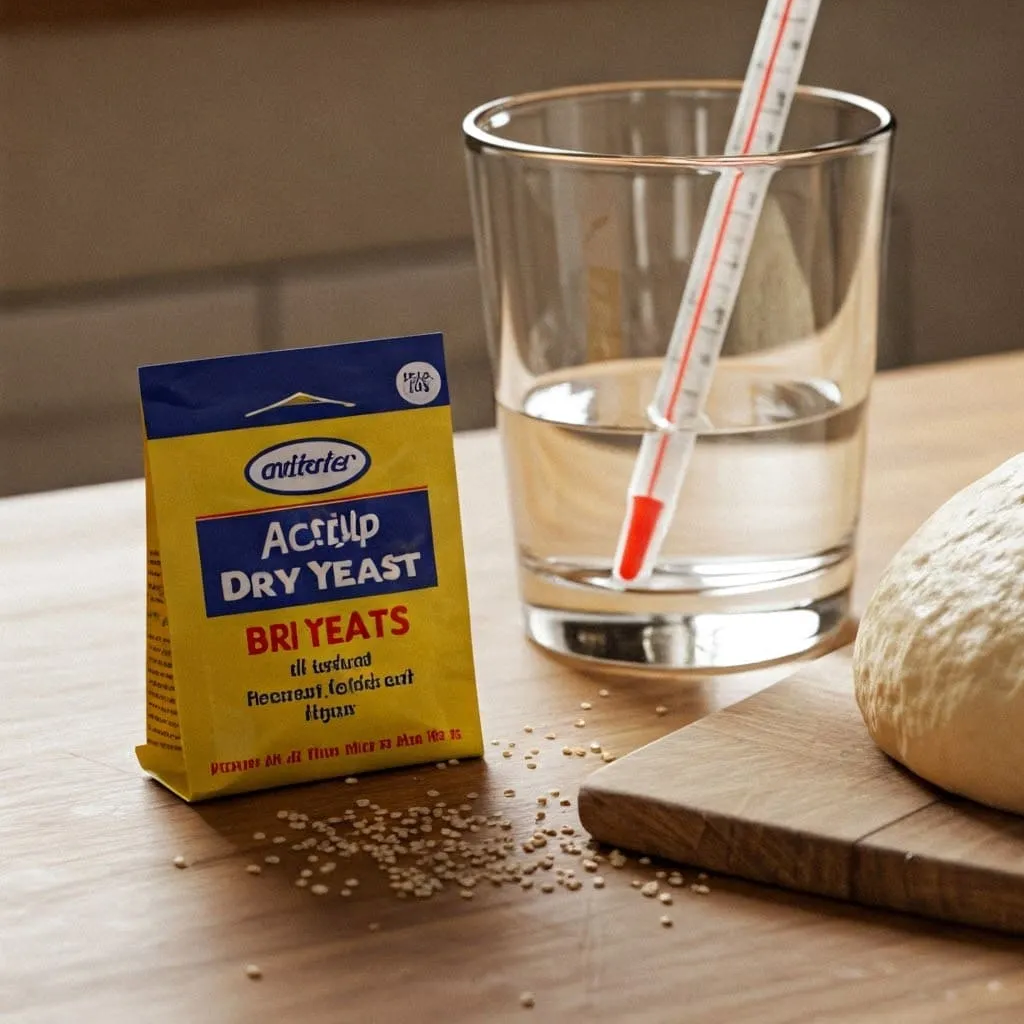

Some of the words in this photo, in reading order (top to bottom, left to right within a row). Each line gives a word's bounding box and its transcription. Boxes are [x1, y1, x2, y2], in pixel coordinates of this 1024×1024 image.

[221, 567, 301, 602] DRY
[307, 552, 421, 590] YEAST
[246, 621, 299, 656] BRI
[304, 605, 410, 648] YEATS
